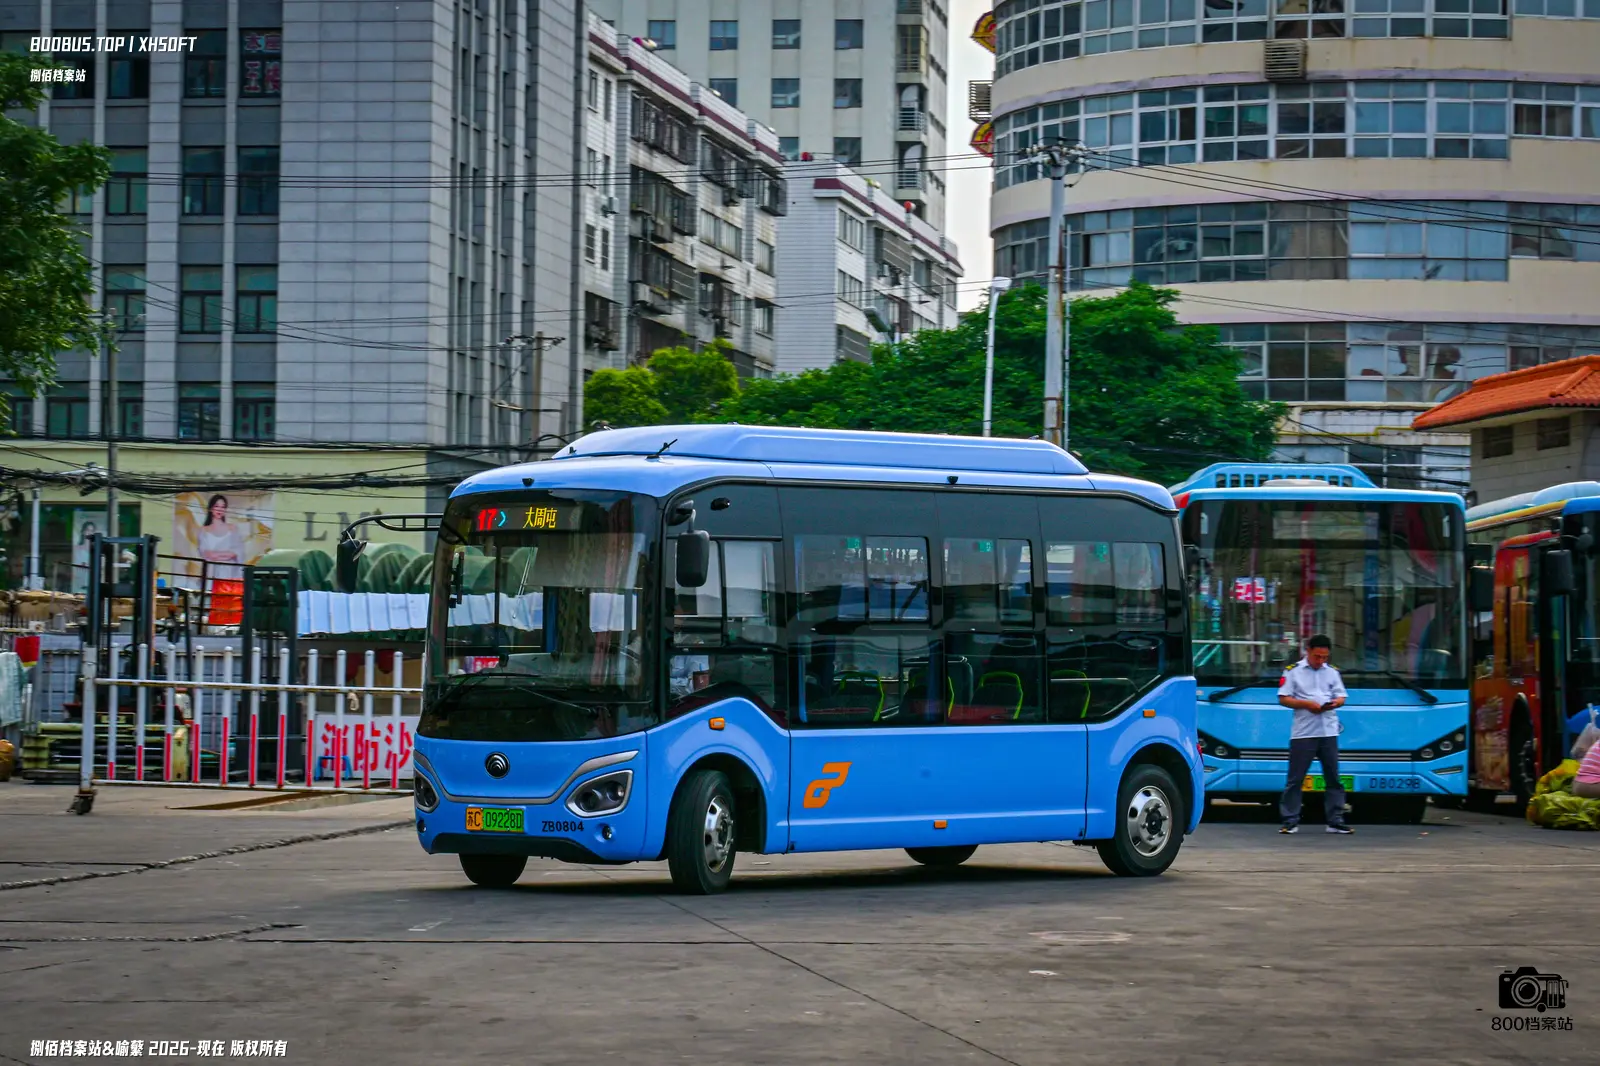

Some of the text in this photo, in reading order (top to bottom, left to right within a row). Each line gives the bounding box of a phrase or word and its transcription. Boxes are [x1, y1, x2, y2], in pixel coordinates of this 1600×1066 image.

[478, 508, 498, 531] 17
[522, 506, 558, 529] 大周屯
[541, 820, 585, 832] ZB0804
